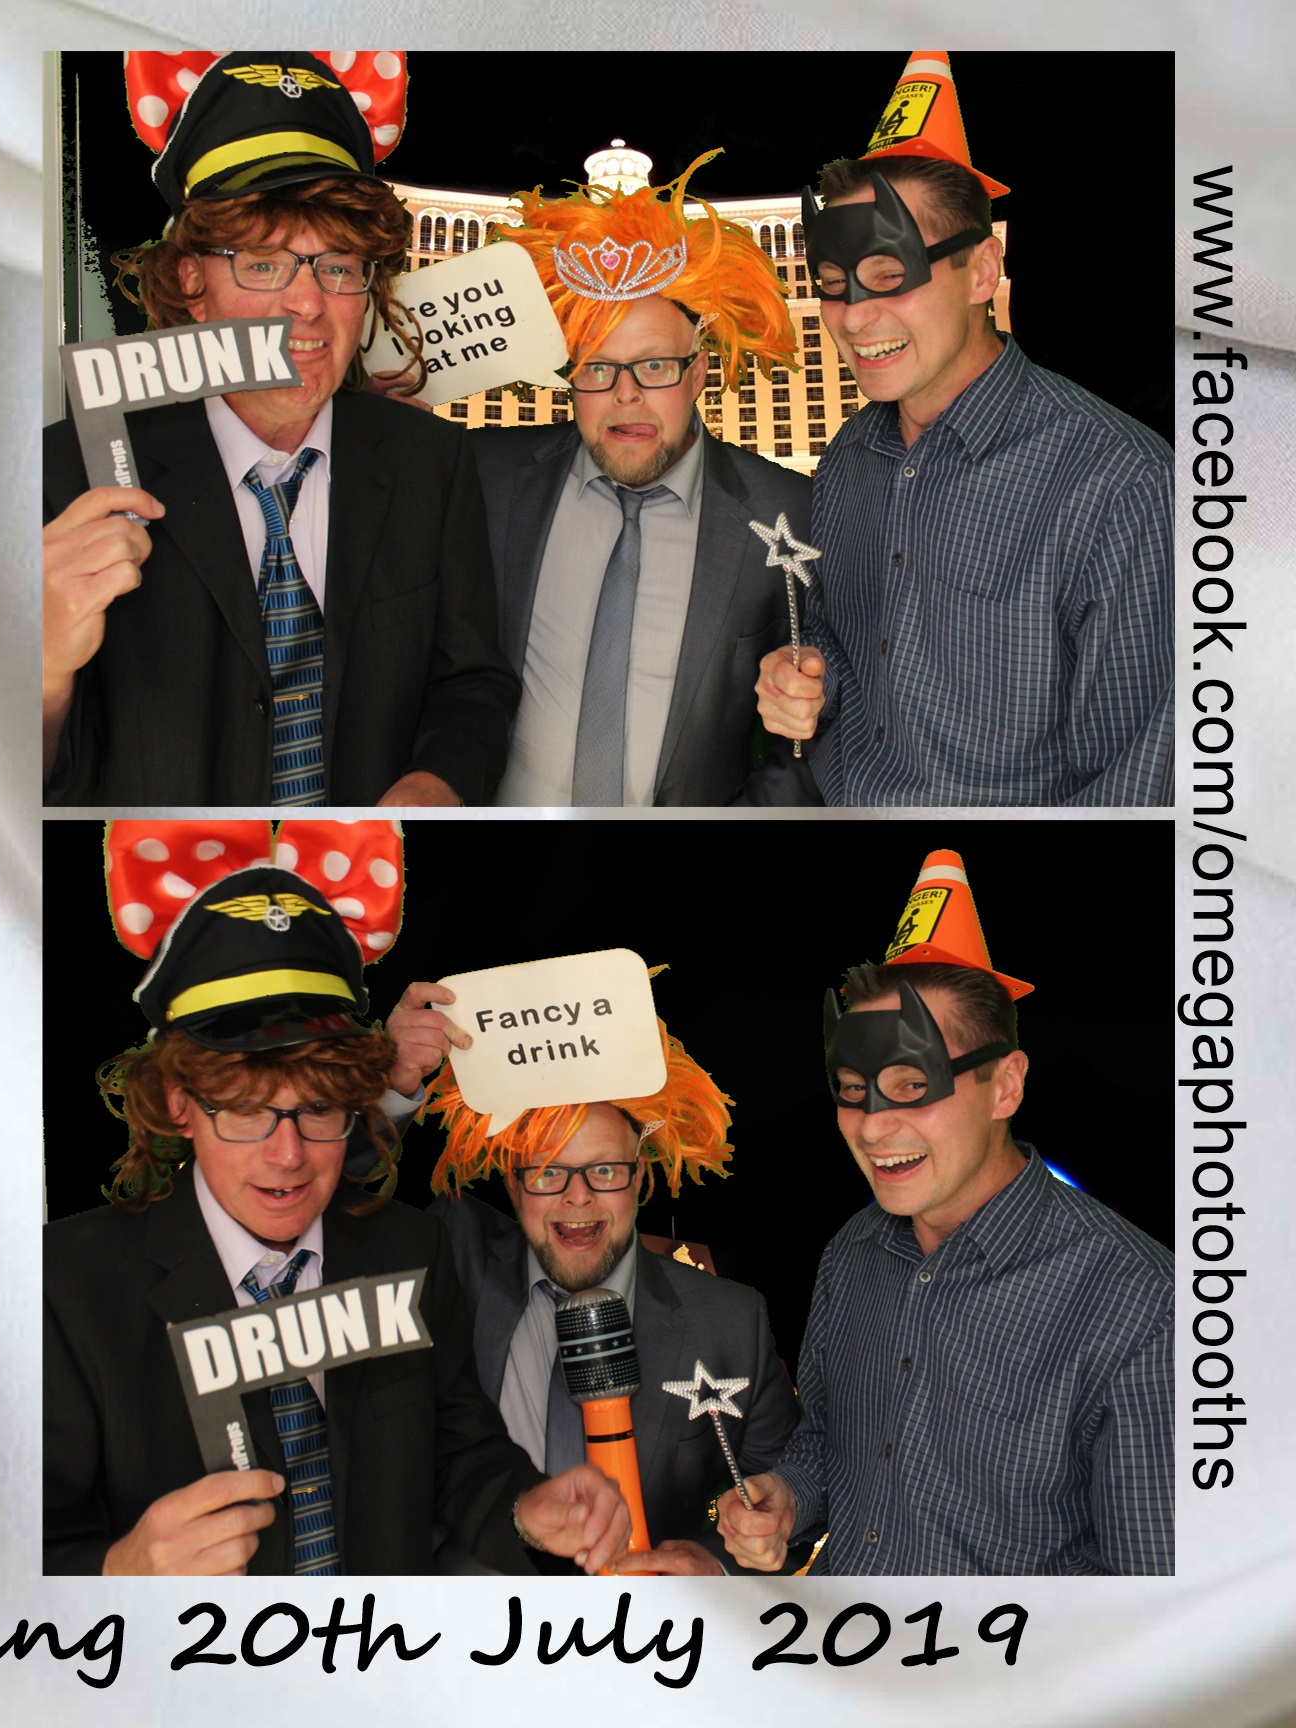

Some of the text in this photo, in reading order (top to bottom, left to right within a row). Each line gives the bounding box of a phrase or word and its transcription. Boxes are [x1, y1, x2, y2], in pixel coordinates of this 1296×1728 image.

[443, 279, 504, 315] you
[72, 325, 292, 410] DRUNK
[426, 337, 508, 374] at me
[476, 998, 613, 1033] Fancy a
[508, 1035, 600, 1065] drink
[183, 1280, 420, 1394] DRUNK
